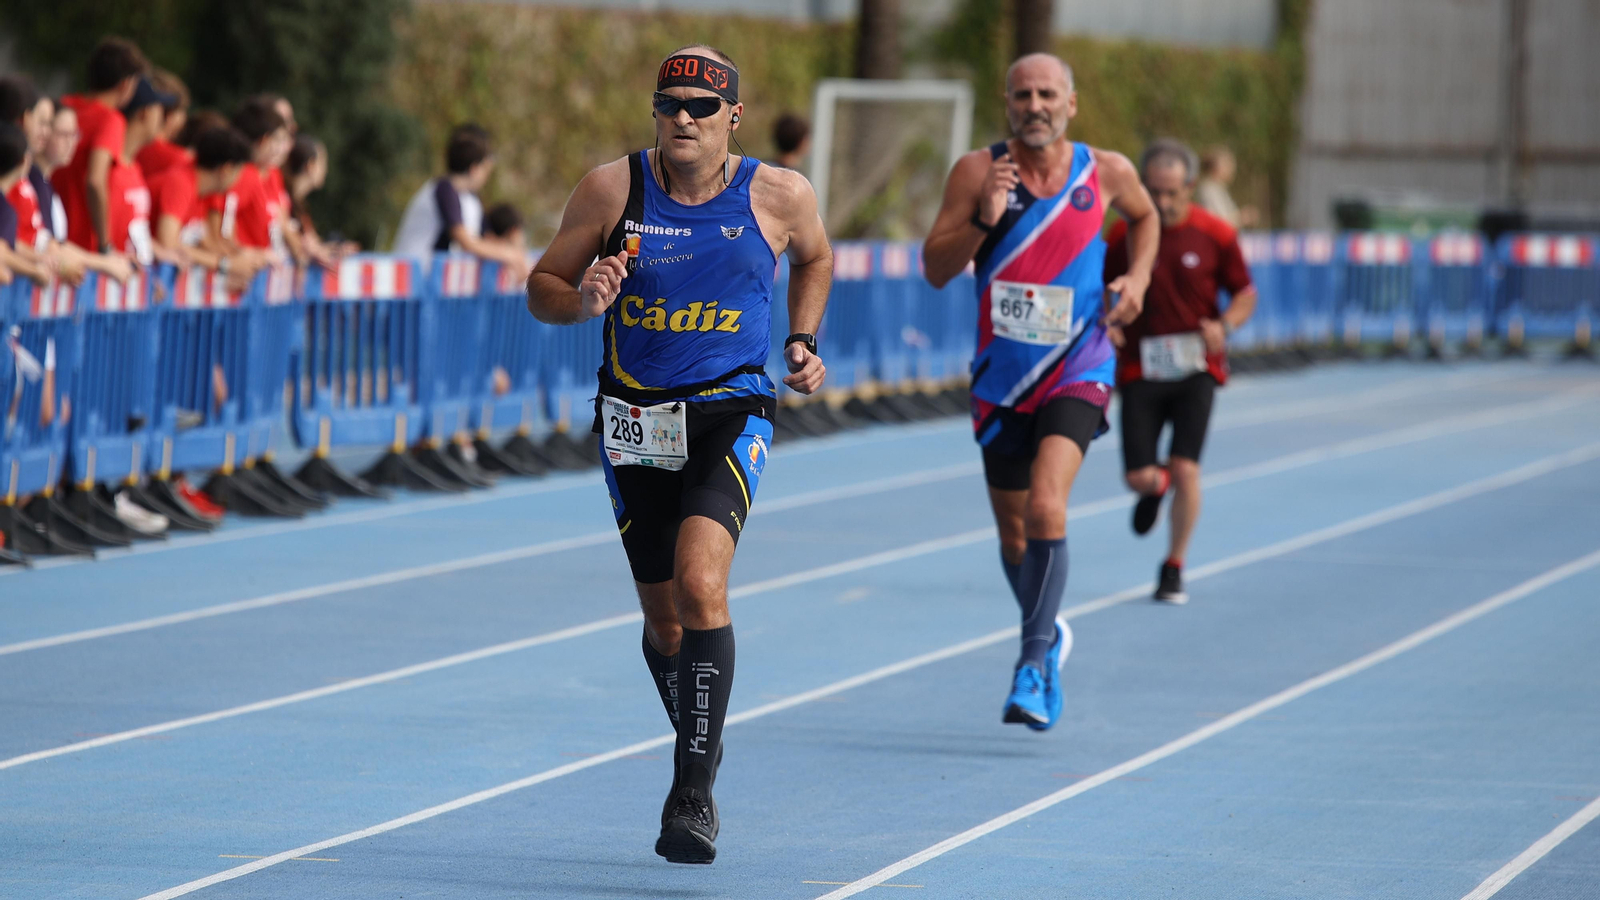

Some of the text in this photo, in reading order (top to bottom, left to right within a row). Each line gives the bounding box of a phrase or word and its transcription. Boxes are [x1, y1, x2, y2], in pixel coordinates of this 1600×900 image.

[659, 58, 699, 82] OTSO
[624, 219, 692, 237] Runners
[663, 241, 675, 251] de
[640, 252, 694, 269] Cervecera
[620, 295, 743, 333] Cádiz
[1000, 299, 1034, 320] 667
[610, 415, 644, 445] 289
